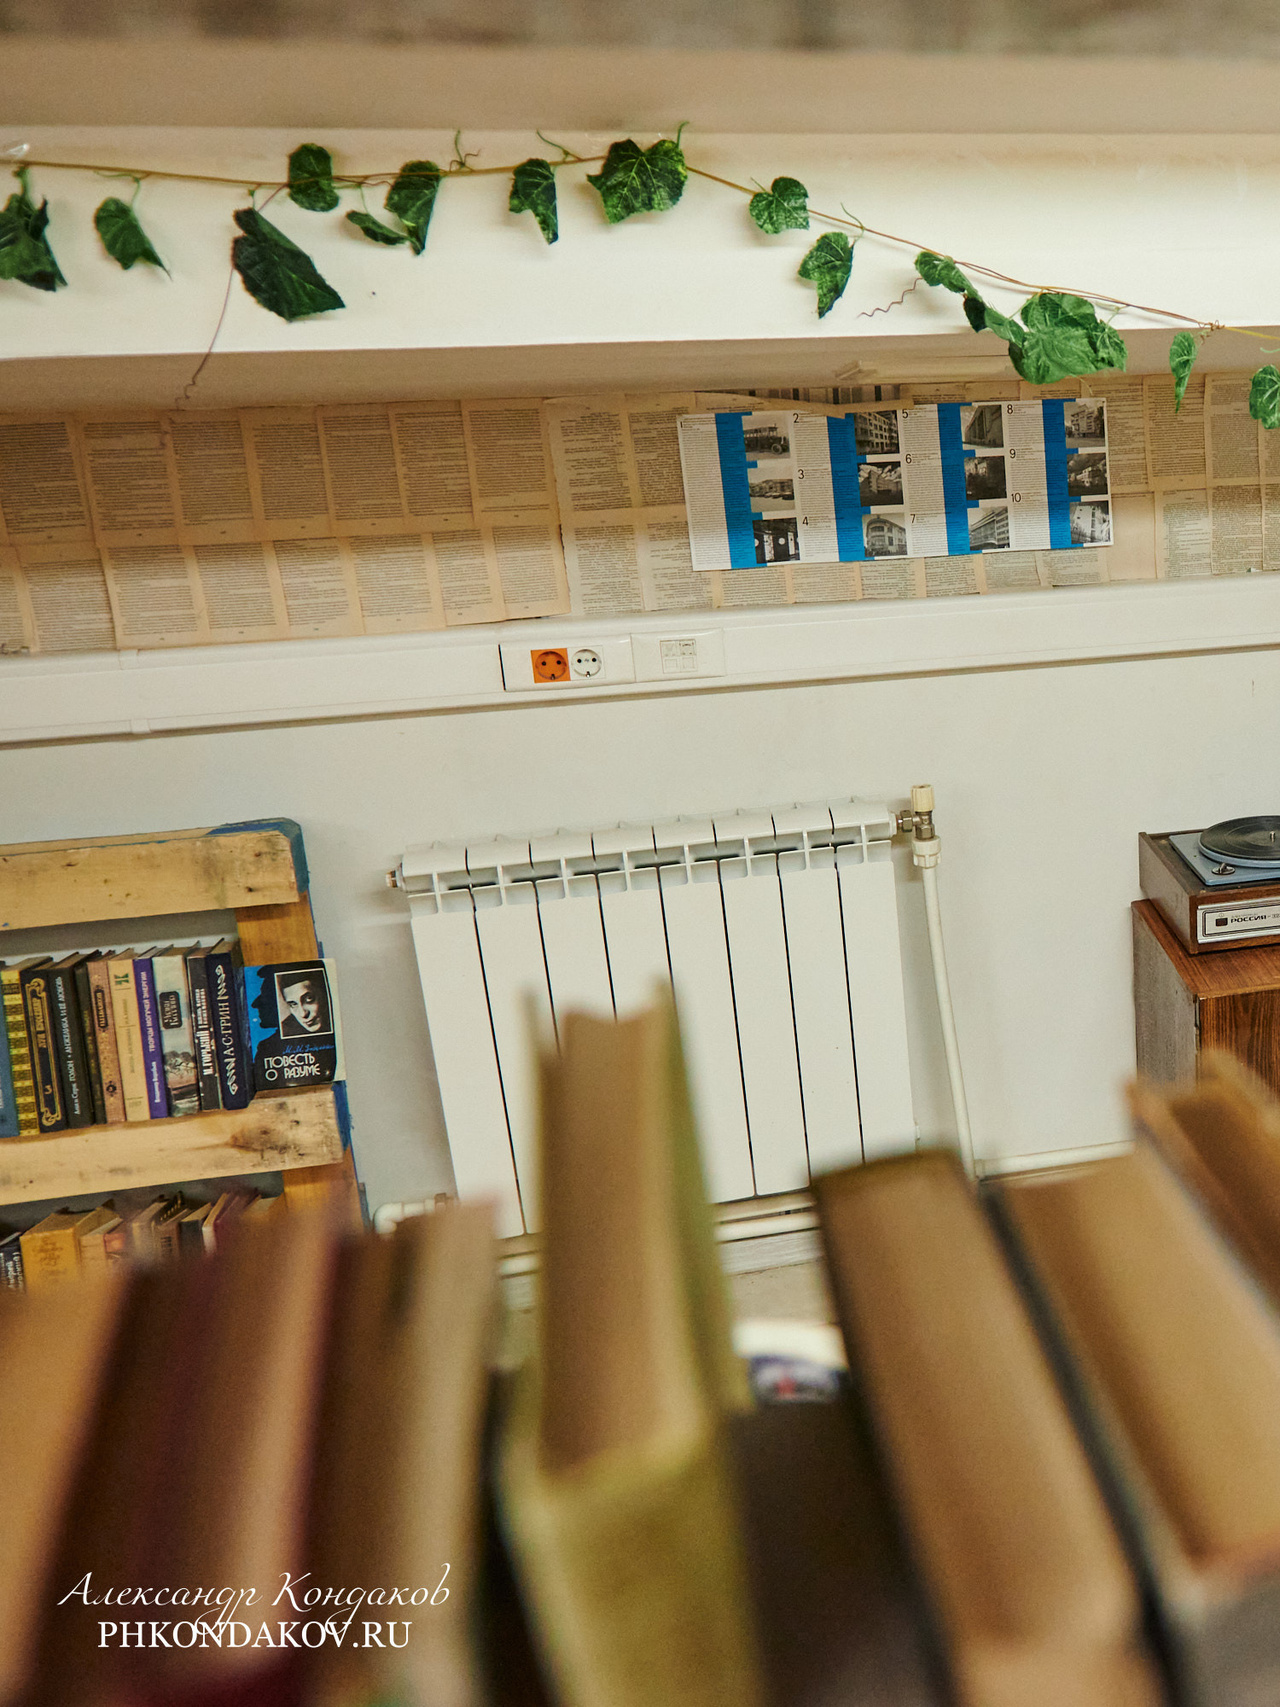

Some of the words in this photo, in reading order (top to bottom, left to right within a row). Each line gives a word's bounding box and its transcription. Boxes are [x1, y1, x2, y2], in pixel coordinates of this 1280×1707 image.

[901, 409, 909, 419] 5
[1006, 404, 1014, 415] 8
[792, 412, 800, 424] 2
[904, 453, 913, 465] 6
[1009, 448, 1017, 459] 9
[797, 469, 806, 480] 3
[1011, 492, 1022, 503] 10
[802, 516, 809, 527] 4
[909, 513, 916, 524] 7
[62, 1016, 72, 1053] АНЖЕЛИКА
[263, 1052, 316, 1070] ПОВЕСТЬ
[265, 1069, 278, 1081] О
[283, 1063, 321, 1079] РАЗУМЕ
